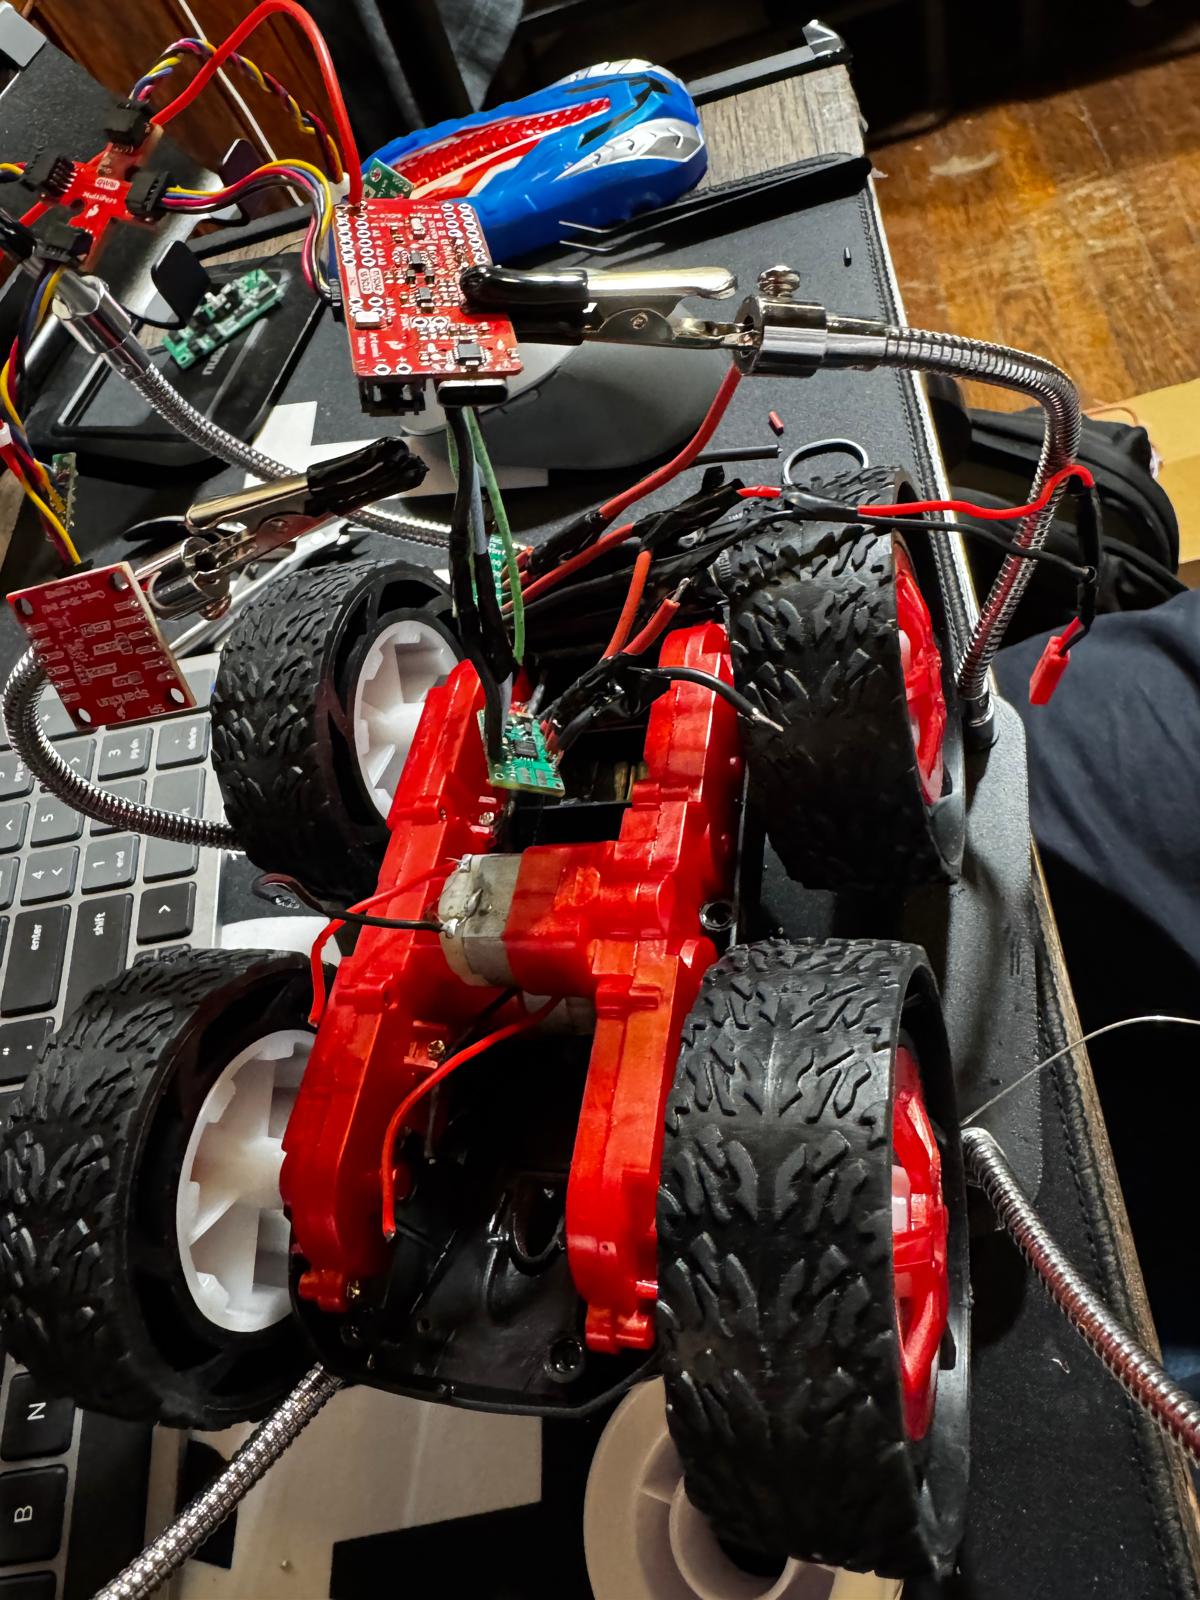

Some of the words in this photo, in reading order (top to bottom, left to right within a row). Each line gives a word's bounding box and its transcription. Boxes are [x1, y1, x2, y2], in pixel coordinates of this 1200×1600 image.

[109, 748, 120, 758] 3
[42, 813, 54, 823] 5
[32, 870, 43, 880] 4
[94, 912, 106, 936] shift
[31, 923, 42, 951] enter
[27, 1402, 46, 1421] N
[14, 1504, 33, 1524] B
